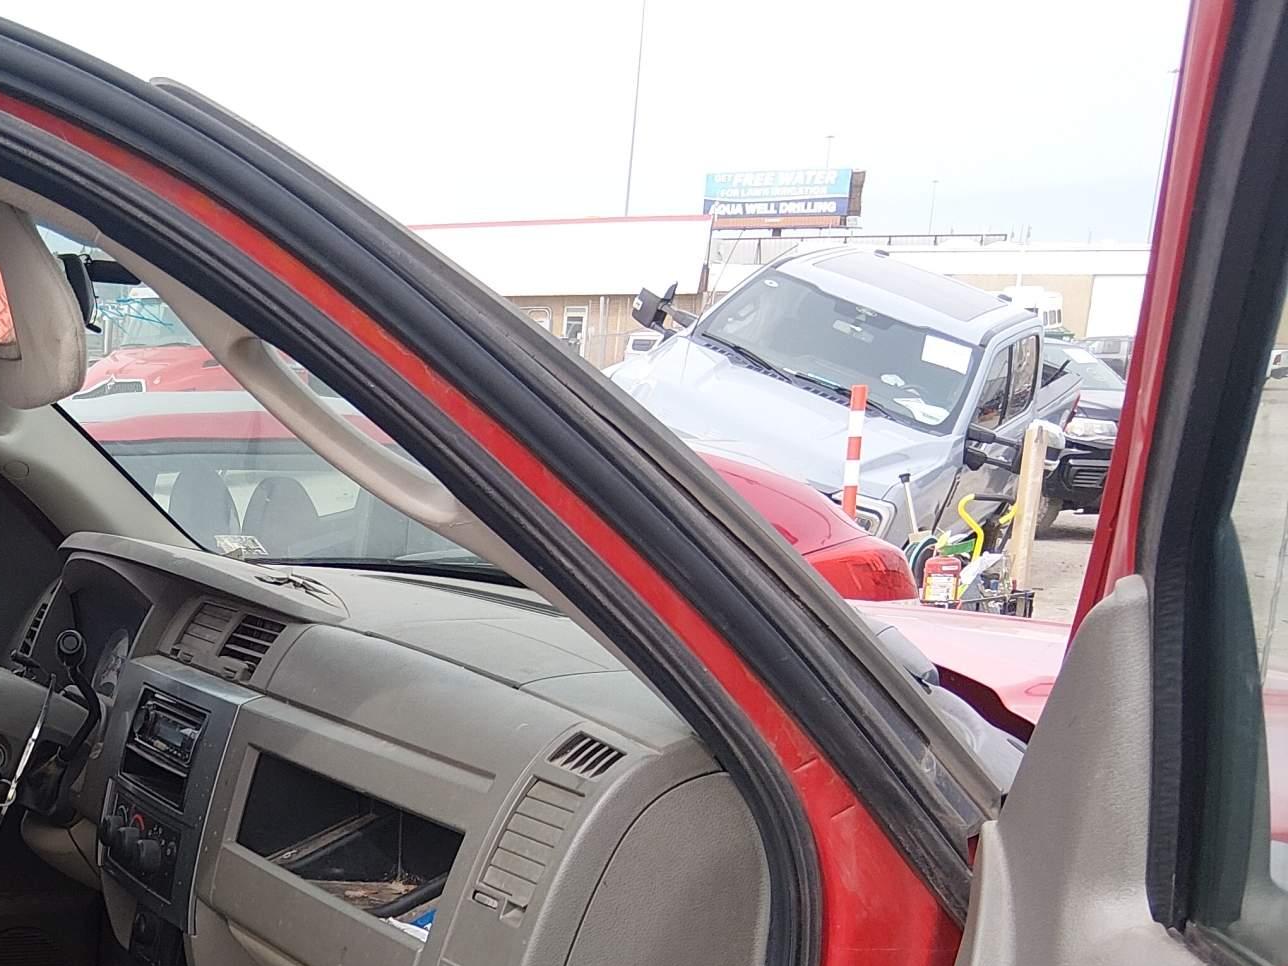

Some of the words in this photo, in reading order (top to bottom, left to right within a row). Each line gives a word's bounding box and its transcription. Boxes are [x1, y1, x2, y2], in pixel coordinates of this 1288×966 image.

[732, 172, 775, 187] FREE
[779, 170, 838, 186] WATER
[744, 202, 777, 215] WELL
[779, 201, 836, 214] DRILLING
